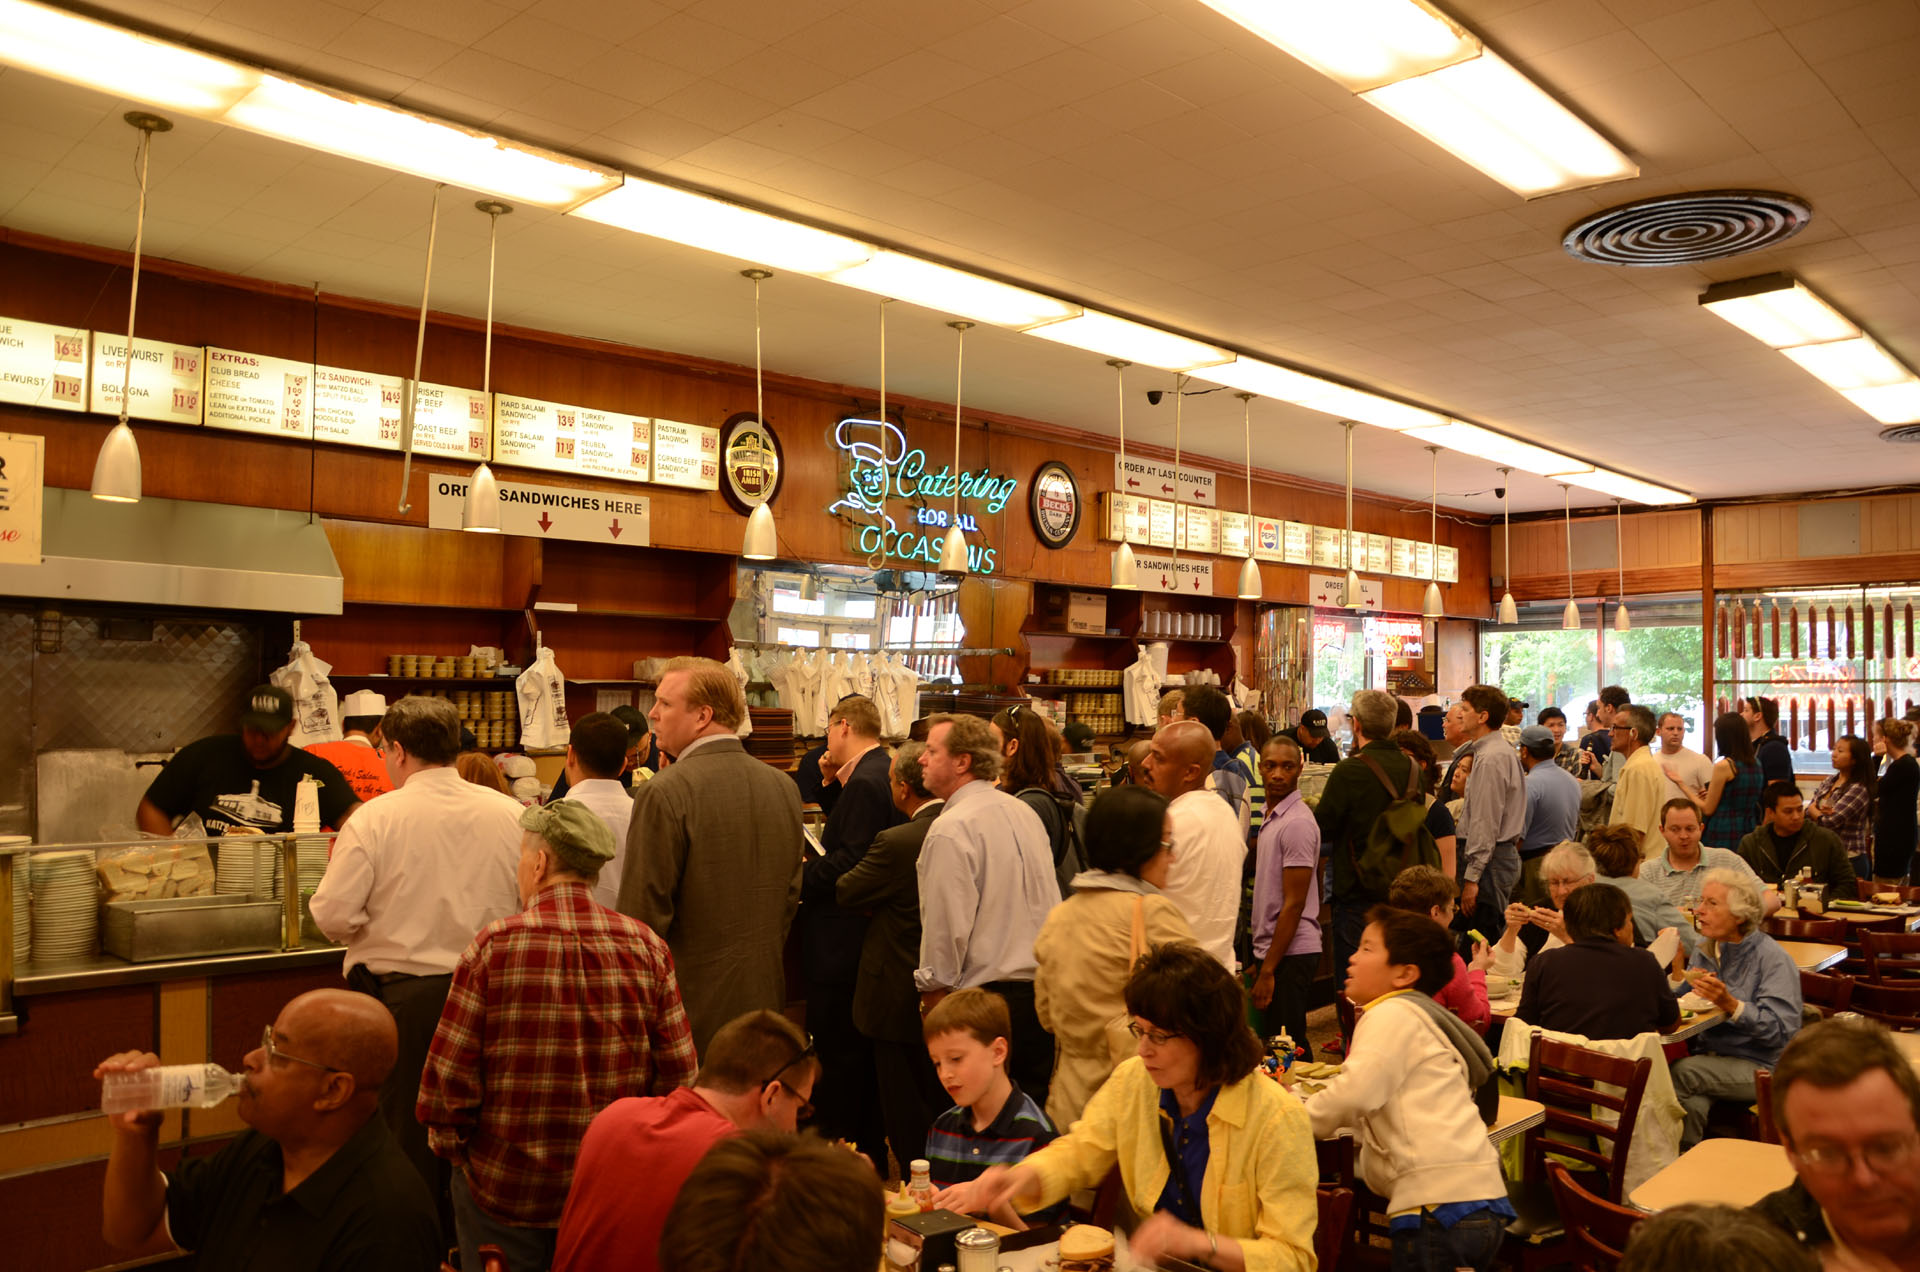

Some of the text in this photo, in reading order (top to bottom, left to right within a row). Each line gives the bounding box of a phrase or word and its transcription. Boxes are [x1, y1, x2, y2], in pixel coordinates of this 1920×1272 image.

[211, 366, 260, 380] CLUB BREAD
[210, 379, 241, 389] CHEESE
[417, 388, 444, 398] RISKET
[209, 392, 238, 402] LETTUCE
[249, 397, 274, 406] TOMATO
[425, 399, 443, 407] BEEF
[236, 405, 257, 413] EXTRA
[259, 407, 276, 415] LEAN
[501, 400, 546, 413] HARD SALAMI
[209, 410, 271, 425] ADDITIONAL PICKLE
[500, 410, 536, 420] SANDWICH
[581, 412, 606, 421] TURKEY
[581, 420, 613, 431] SANDWICH
[658, 425, 687, 435] PASTRAMI
[500, 430, 544, 441] SOFT SALAMI
[658, 434, 688, 444] SANDWICH
[500, 439, 536, 449] SANDWICH
[581, 440, 606, 448] REUBEN
[581, 448, 613, 458] SANDWICH
[658, 463, 688, 473] SANDWICH
[1118, 461, 1212, 486] ORDER AT LAST COUNTER
[742, 477, 760, 485] AMBE
[897, 450, 1016, 513] Catering
[499, 489, 600, 511] SANDWICHES
[604, 500, 643, 515] HERE
[1261, 532, 1276, 541] PEPSI
[860, 526, 996, 574] OCCASNS
[1143, 560, 1209, 574] SANDWICHES HERE
